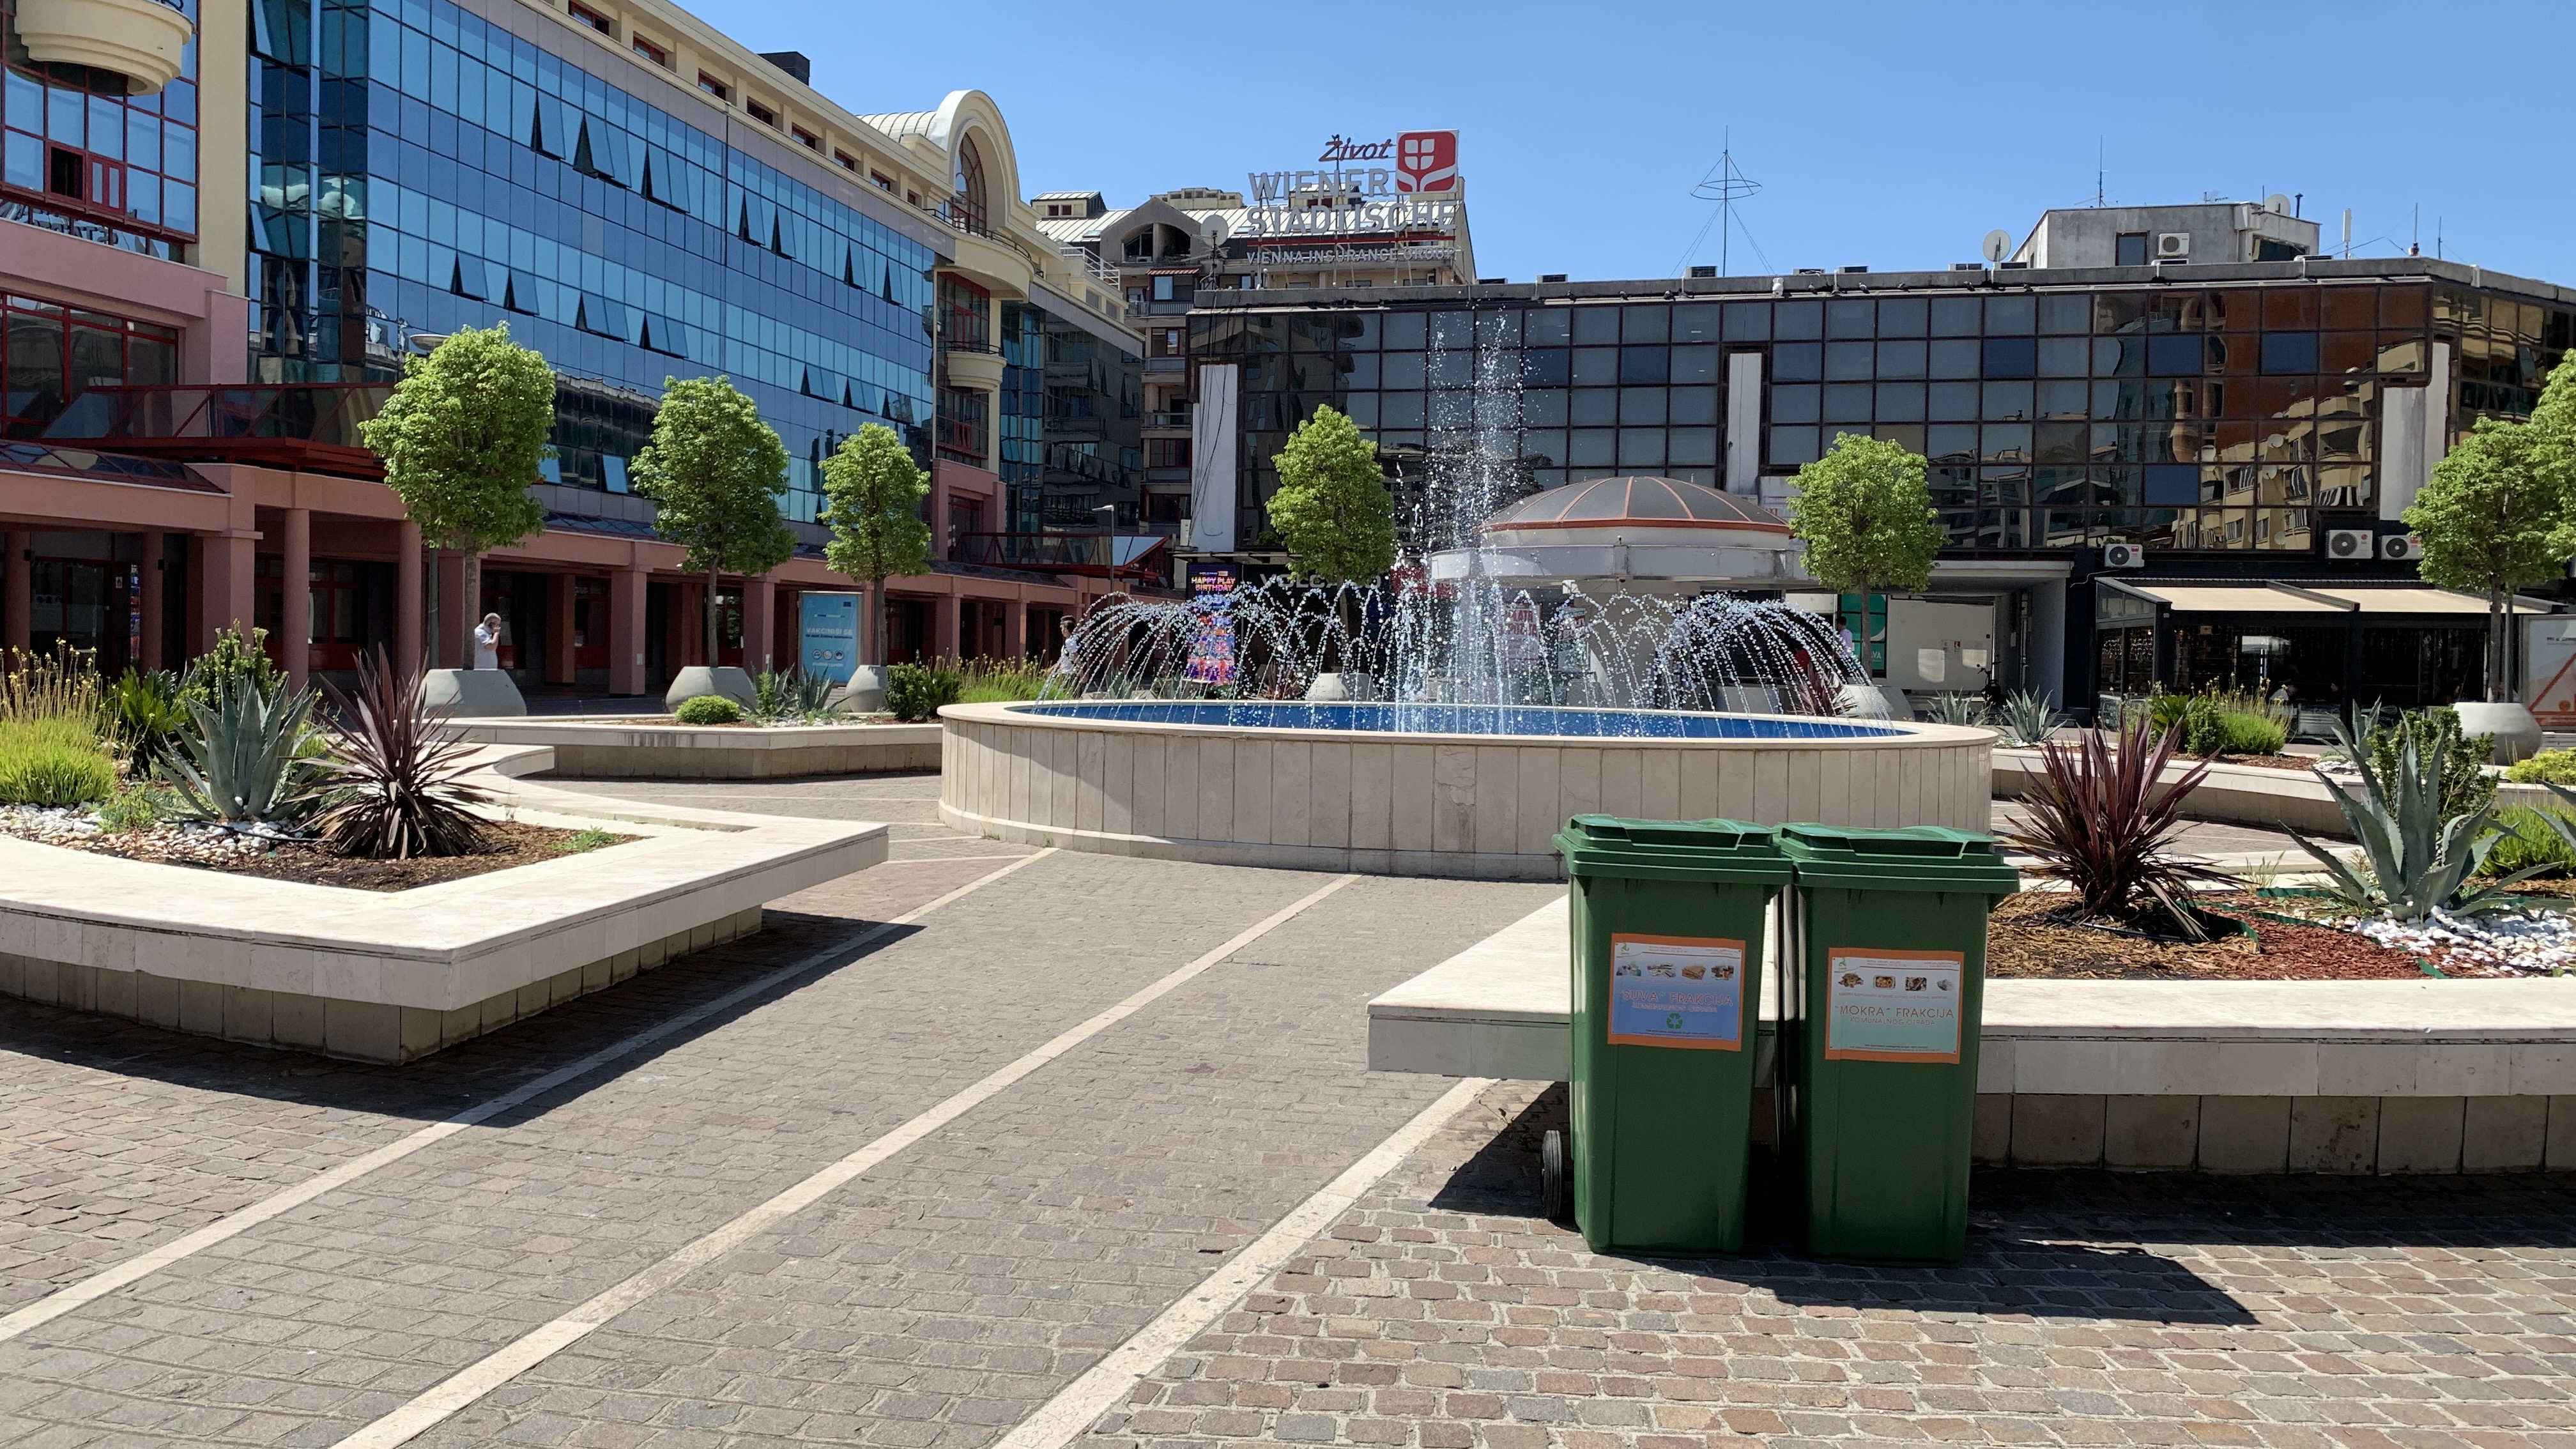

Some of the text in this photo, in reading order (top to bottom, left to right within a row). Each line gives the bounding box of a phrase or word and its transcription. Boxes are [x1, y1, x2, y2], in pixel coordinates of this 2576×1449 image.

[1318, 134, 1392, 162] Život
[1248, 167, 1389, 201] WIENER
[1246, 246, 1457, 264] VIENNA INSURANCE GROUP
[1670, 992, 1733, 1006] FRAKCIJA
[1896, 1008, 1954, 1018] FRAKCIJA
